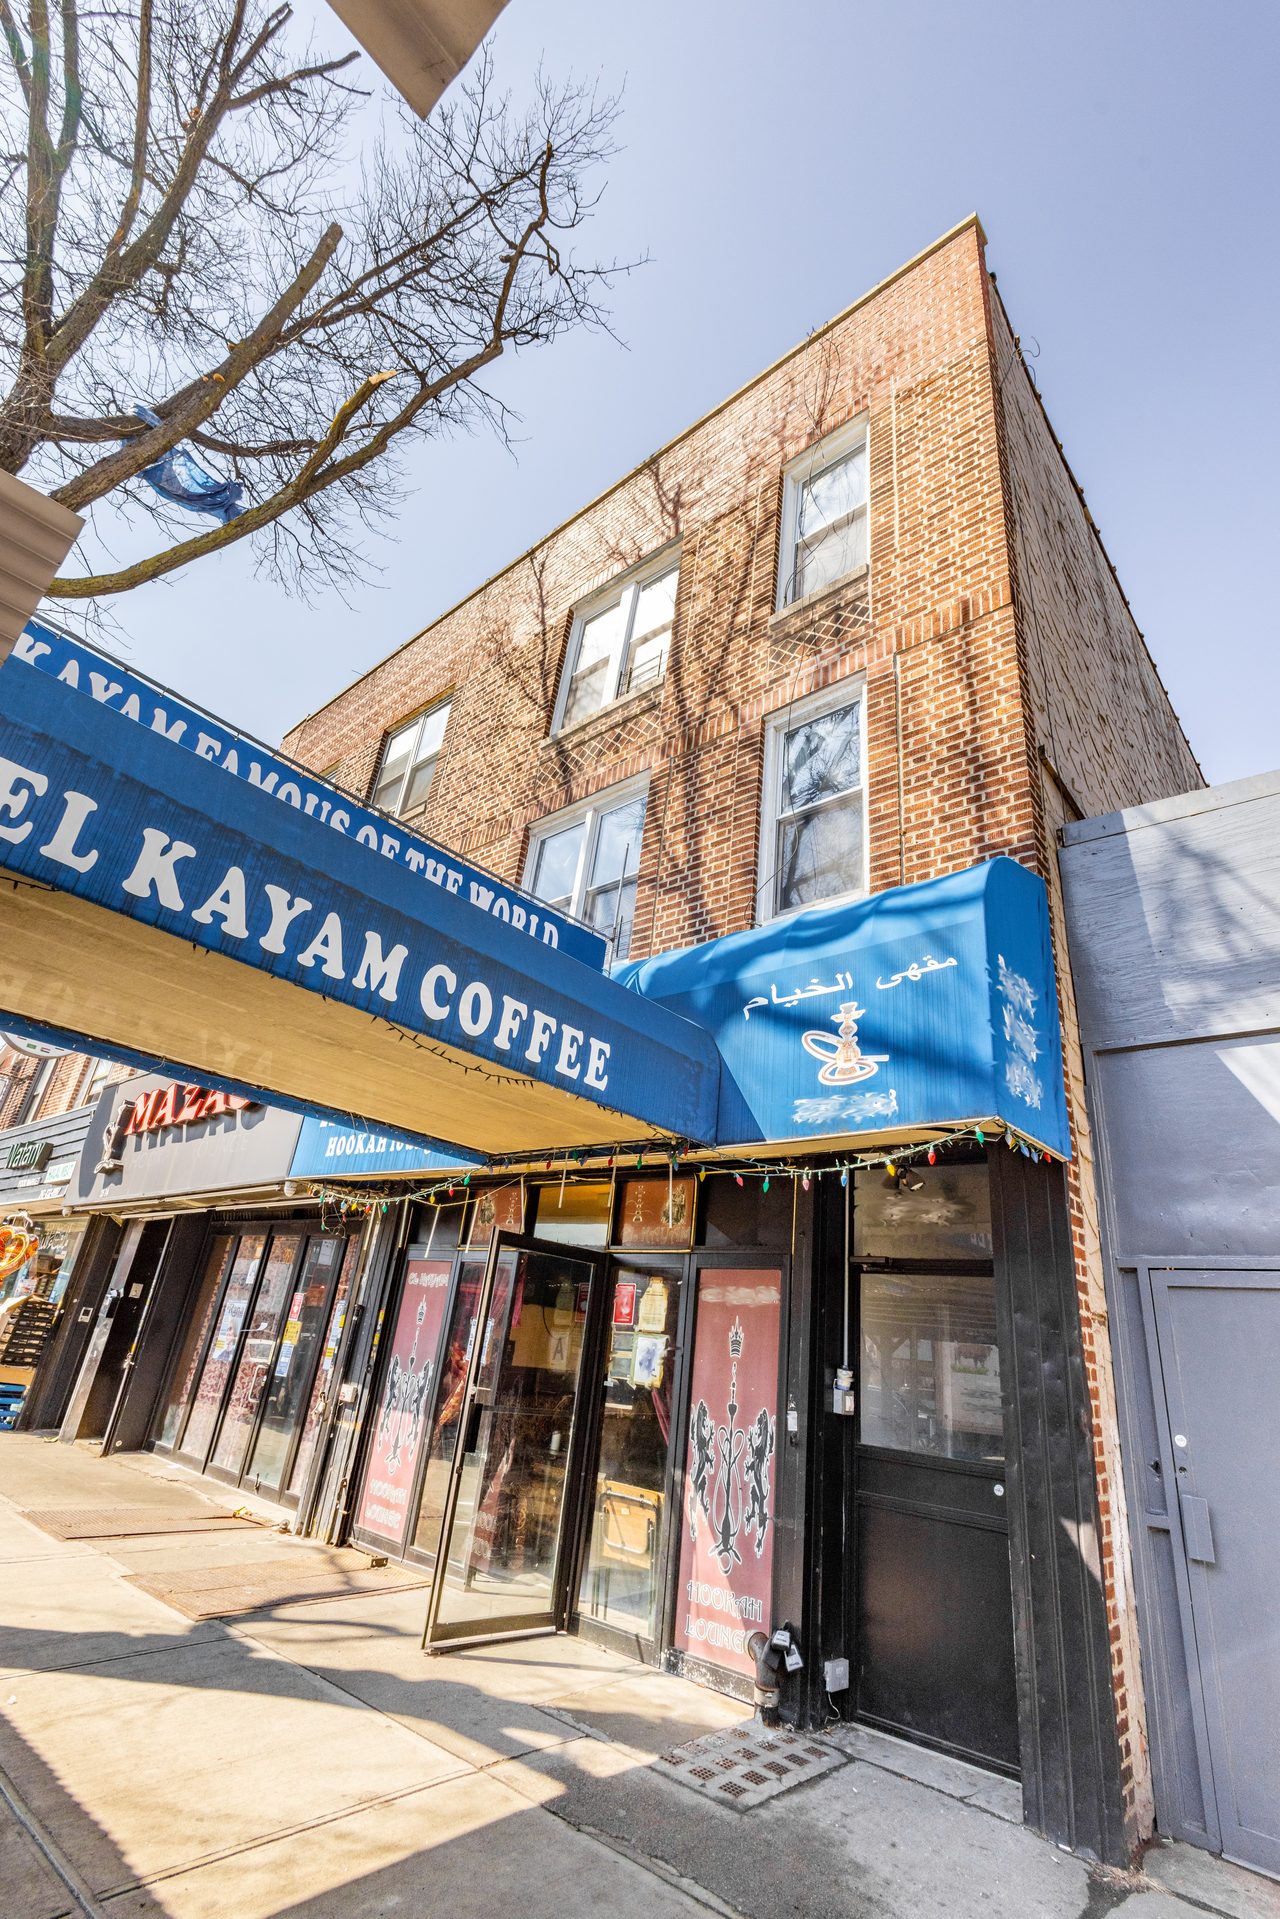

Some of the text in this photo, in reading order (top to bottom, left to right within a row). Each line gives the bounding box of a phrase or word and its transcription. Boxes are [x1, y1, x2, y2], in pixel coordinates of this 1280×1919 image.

[355, 825, 401, 859] OF
[0, 757, 611, 1092] EL KAYAM COFFEE
[743, 954, 958, 1021] مقهى الخيام
[324, 1133, 388, 1158] HOOKAH
[686, 1580, 763, 1623] HOOKAH
